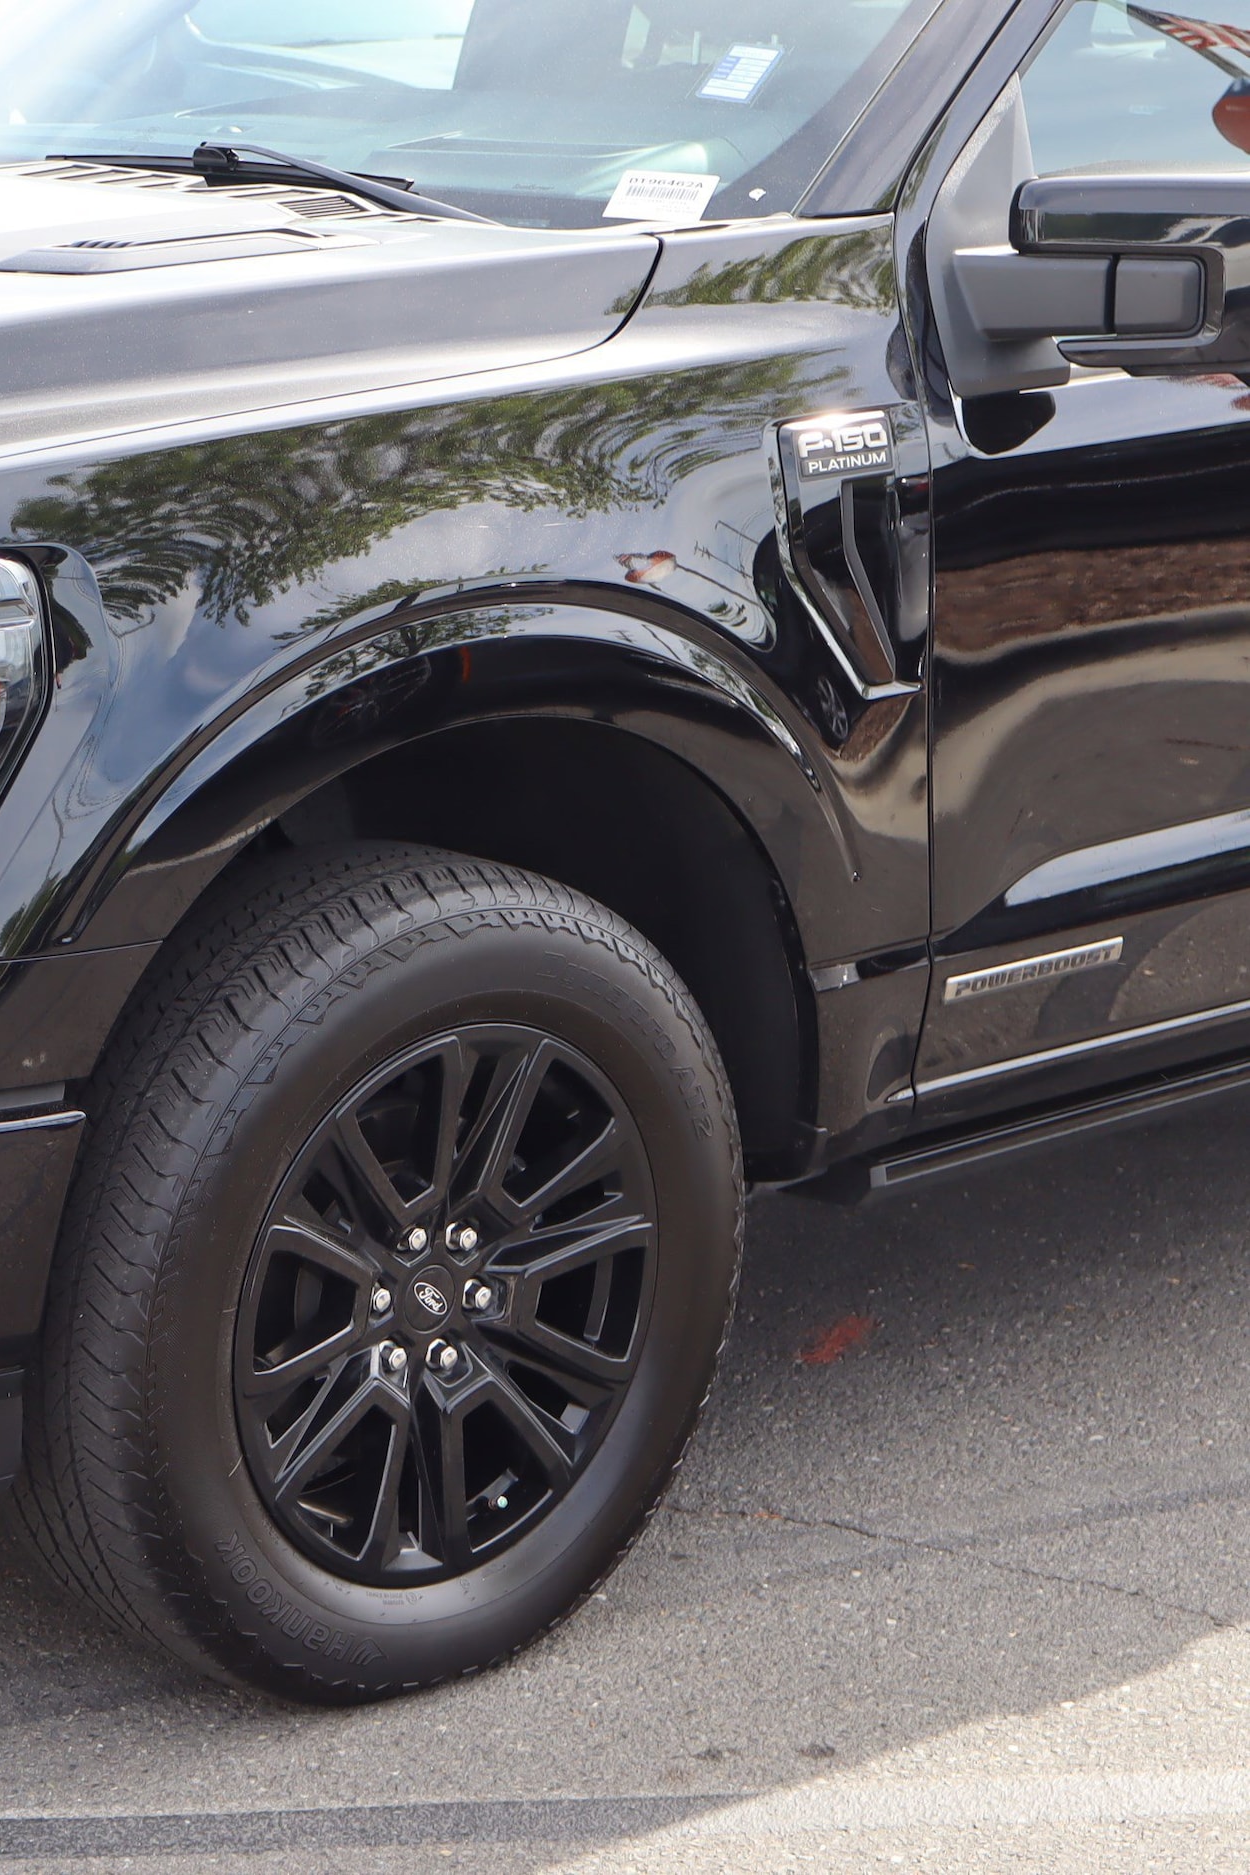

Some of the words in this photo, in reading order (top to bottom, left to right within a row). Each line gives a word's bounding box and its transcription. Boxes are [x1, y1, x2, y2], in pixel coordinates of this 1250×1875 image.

[797, 422, 888, 458] F-150
[808, 451, 887, 474] PLATINUM
[954, 944, 1116, 997] POWERBOOST
[418, 1287, 443, 1311] Ford
